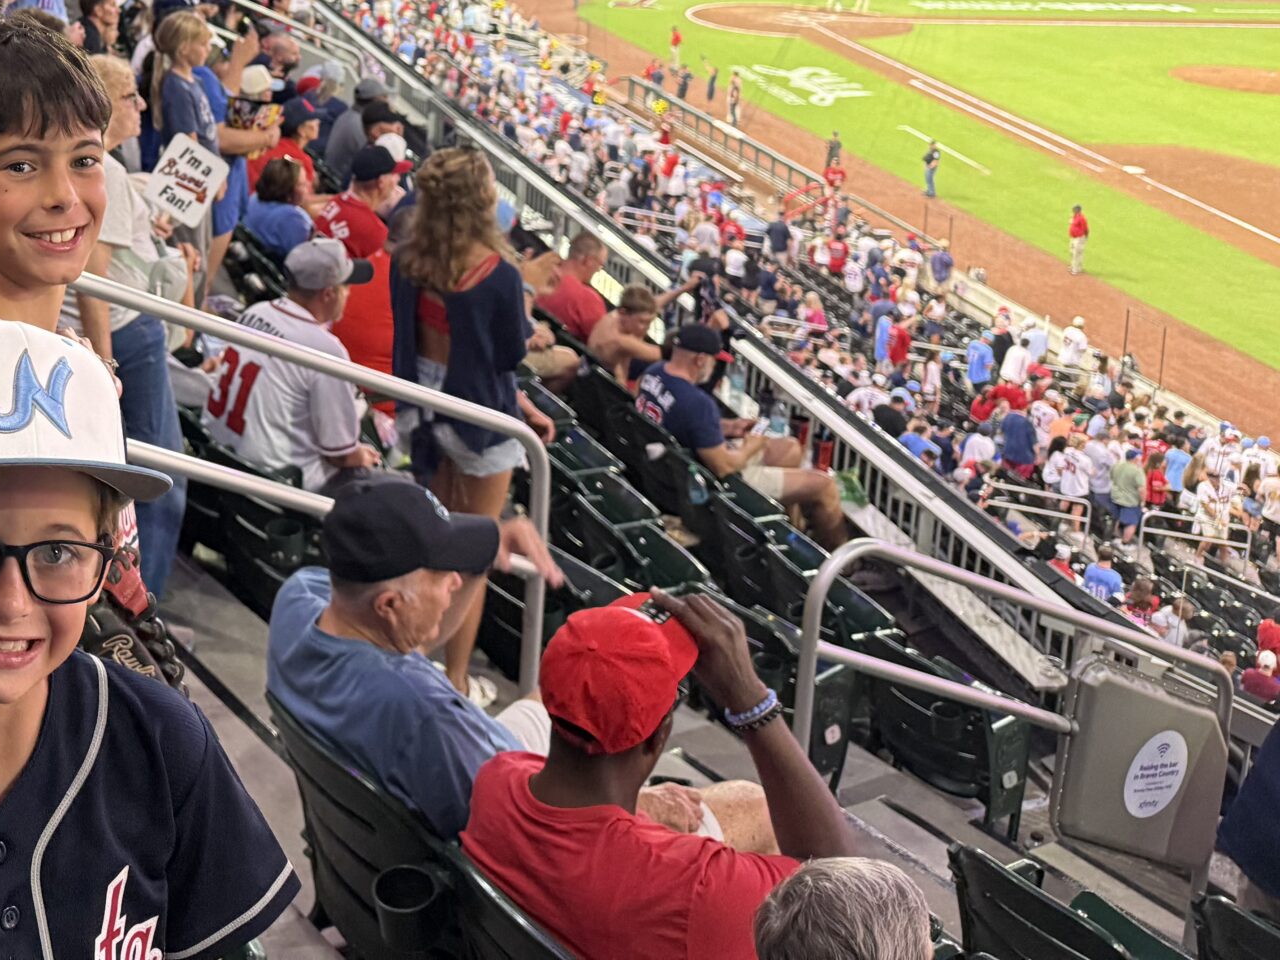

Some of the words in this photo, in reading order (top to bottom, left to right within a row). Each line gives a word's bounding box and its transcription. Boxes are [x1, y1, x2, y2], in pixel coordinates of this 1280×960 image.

[178, 146, 202, 171] I'm
[201, 165, 212, 177] a
[158, 184, 192, 213] Fan!
[207, 346, 262, 437] 31
